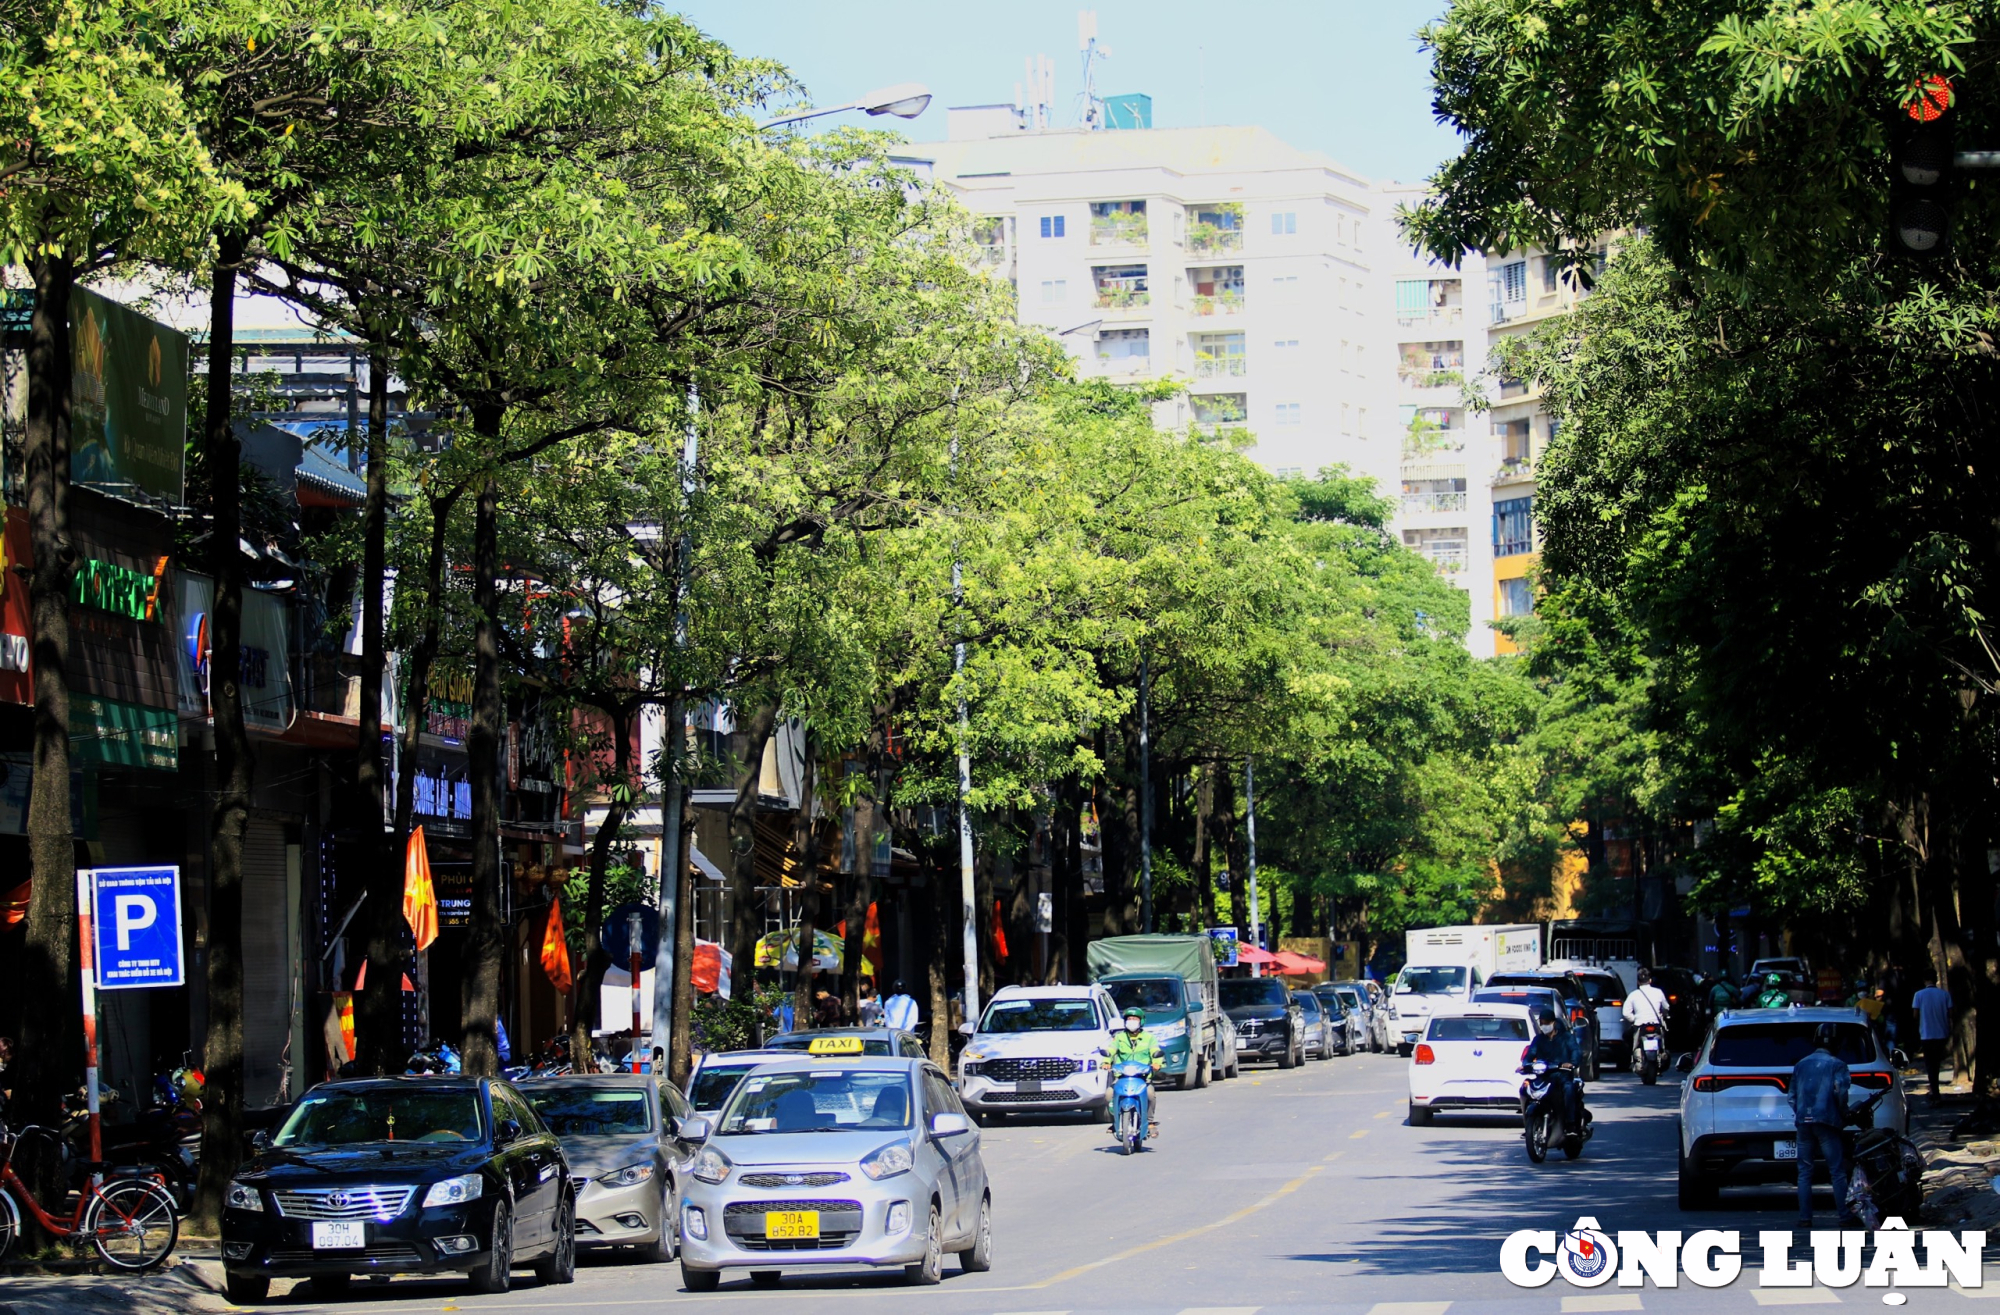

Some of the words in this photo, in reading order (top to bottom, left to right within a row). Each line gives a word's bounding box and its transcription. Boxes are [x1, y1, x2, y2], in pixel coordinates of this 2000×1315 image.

[98, 878, 107, 888] SỞ
[106, 879, 118, 888] GIAO
[118, 878, 135, 887] THÔNG
[135, 877, 146, 887] VẬN
[146, 876, 155, 886] TẢI
[155, 877, 162, 886] HÀ
[162, 876, 172, 886] NỘI
[440, 870, 467, 885] PHỦI
[440, 898, 471, 908] TRUNG
[115, 894, 157, 951] P
[118, 959, 131, 968] CÔNG
[131, 960, 138, 968] TY
[150, 959, 161, 967] MTV
[118, 969, 131, 978] THÁC
[130, 969, 142, 978] ĐIỂM
[150, 969, 157, 977] XE
[157, 967, 164, 977] HÀ
[163, 967, 173, 977] NỘI
[816, 1038, 853, 1050] TAXI
[1785, 1140, 1797, 1149] 30
[781, 1213, 803, 1224] 30A
[328, 1223, 349, 1235] 30H
[772, 1225, 814, 1237] 852.82
[319, 1235, 359, 1248] 097.04
